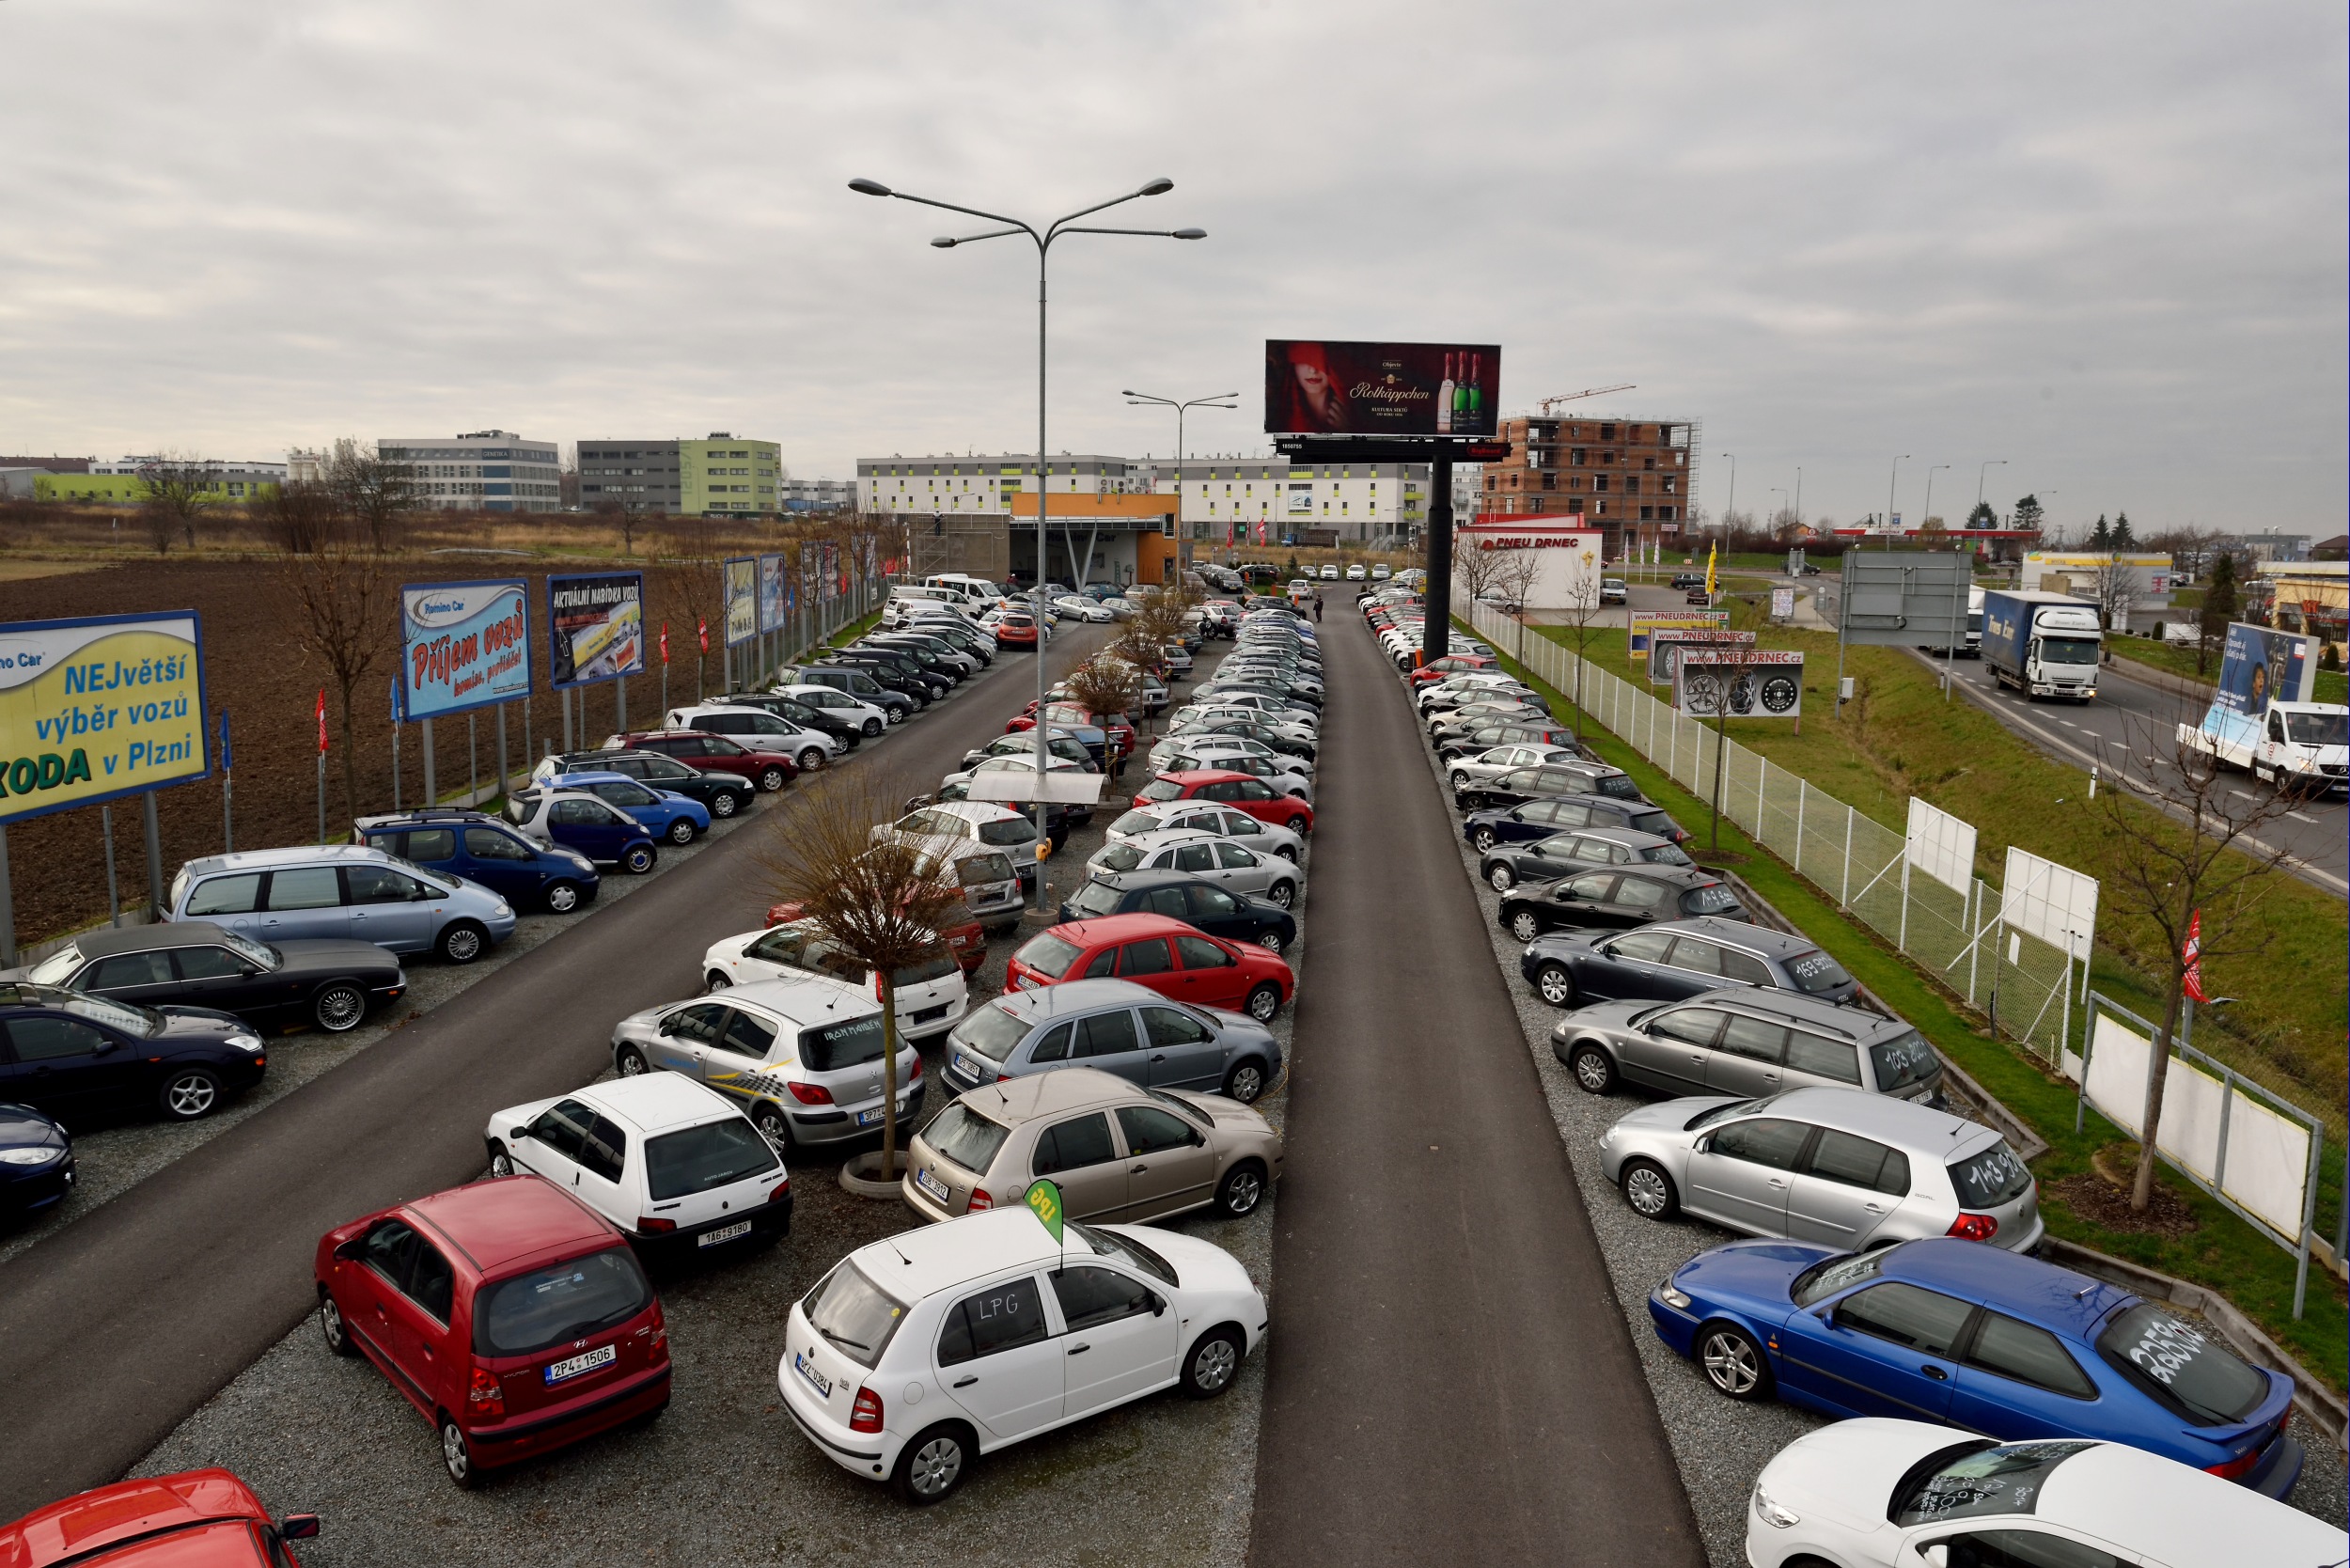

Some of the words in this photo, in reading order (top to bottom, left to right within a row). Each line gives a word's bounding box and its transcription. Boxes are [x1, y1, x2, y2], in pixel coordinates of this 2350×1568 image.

[1349, 382, 1430, 402] Rotkäppchen
[1496, 538, 1531, 547] PNEU
[1535, 538, 1578, 548] DRNEC
[554, 585, 589, 608] AKTUÁLNÍ
[591, 583, 620, 604] NABÍDKA
[622, 581, 639, 602] VOZŮ
[424, 603, 451, 614] Romino
[452, 601, 463, 611] Car
[412, 633, 478, 690] Příjem
[484, 598, 524, 655] vozů
[17, 651, 42, 666] Car
[65, 653, 188, 696] NEJvětší
[36, 703, 118, 745] výběr
[128, 690, 188, 725] vozů
[102, 754, 118, 776] v
[128, 732, 192, 771] Plzni
[1796, 961, 1818, 979] 169
[823, 1029, 849, 1041] IRON
[848, 1020, 882, 1035] MAIDEN
[1885, 1049, 1909, 1071] 103
[864, 1110, 876, 1121] 3P7
[933, 1181, 947, 1197] 3912
[706, 1231, 721, 1243] 1A6
[727, 1222, 747, 1237] 9180
[979, 1294, 1018, 1320] LPG
[554, 1359, 574, 1377] 2P4
[584, 1348, 610, 1367] 1506
[2013, 1486, 2033, 1507] 2014
